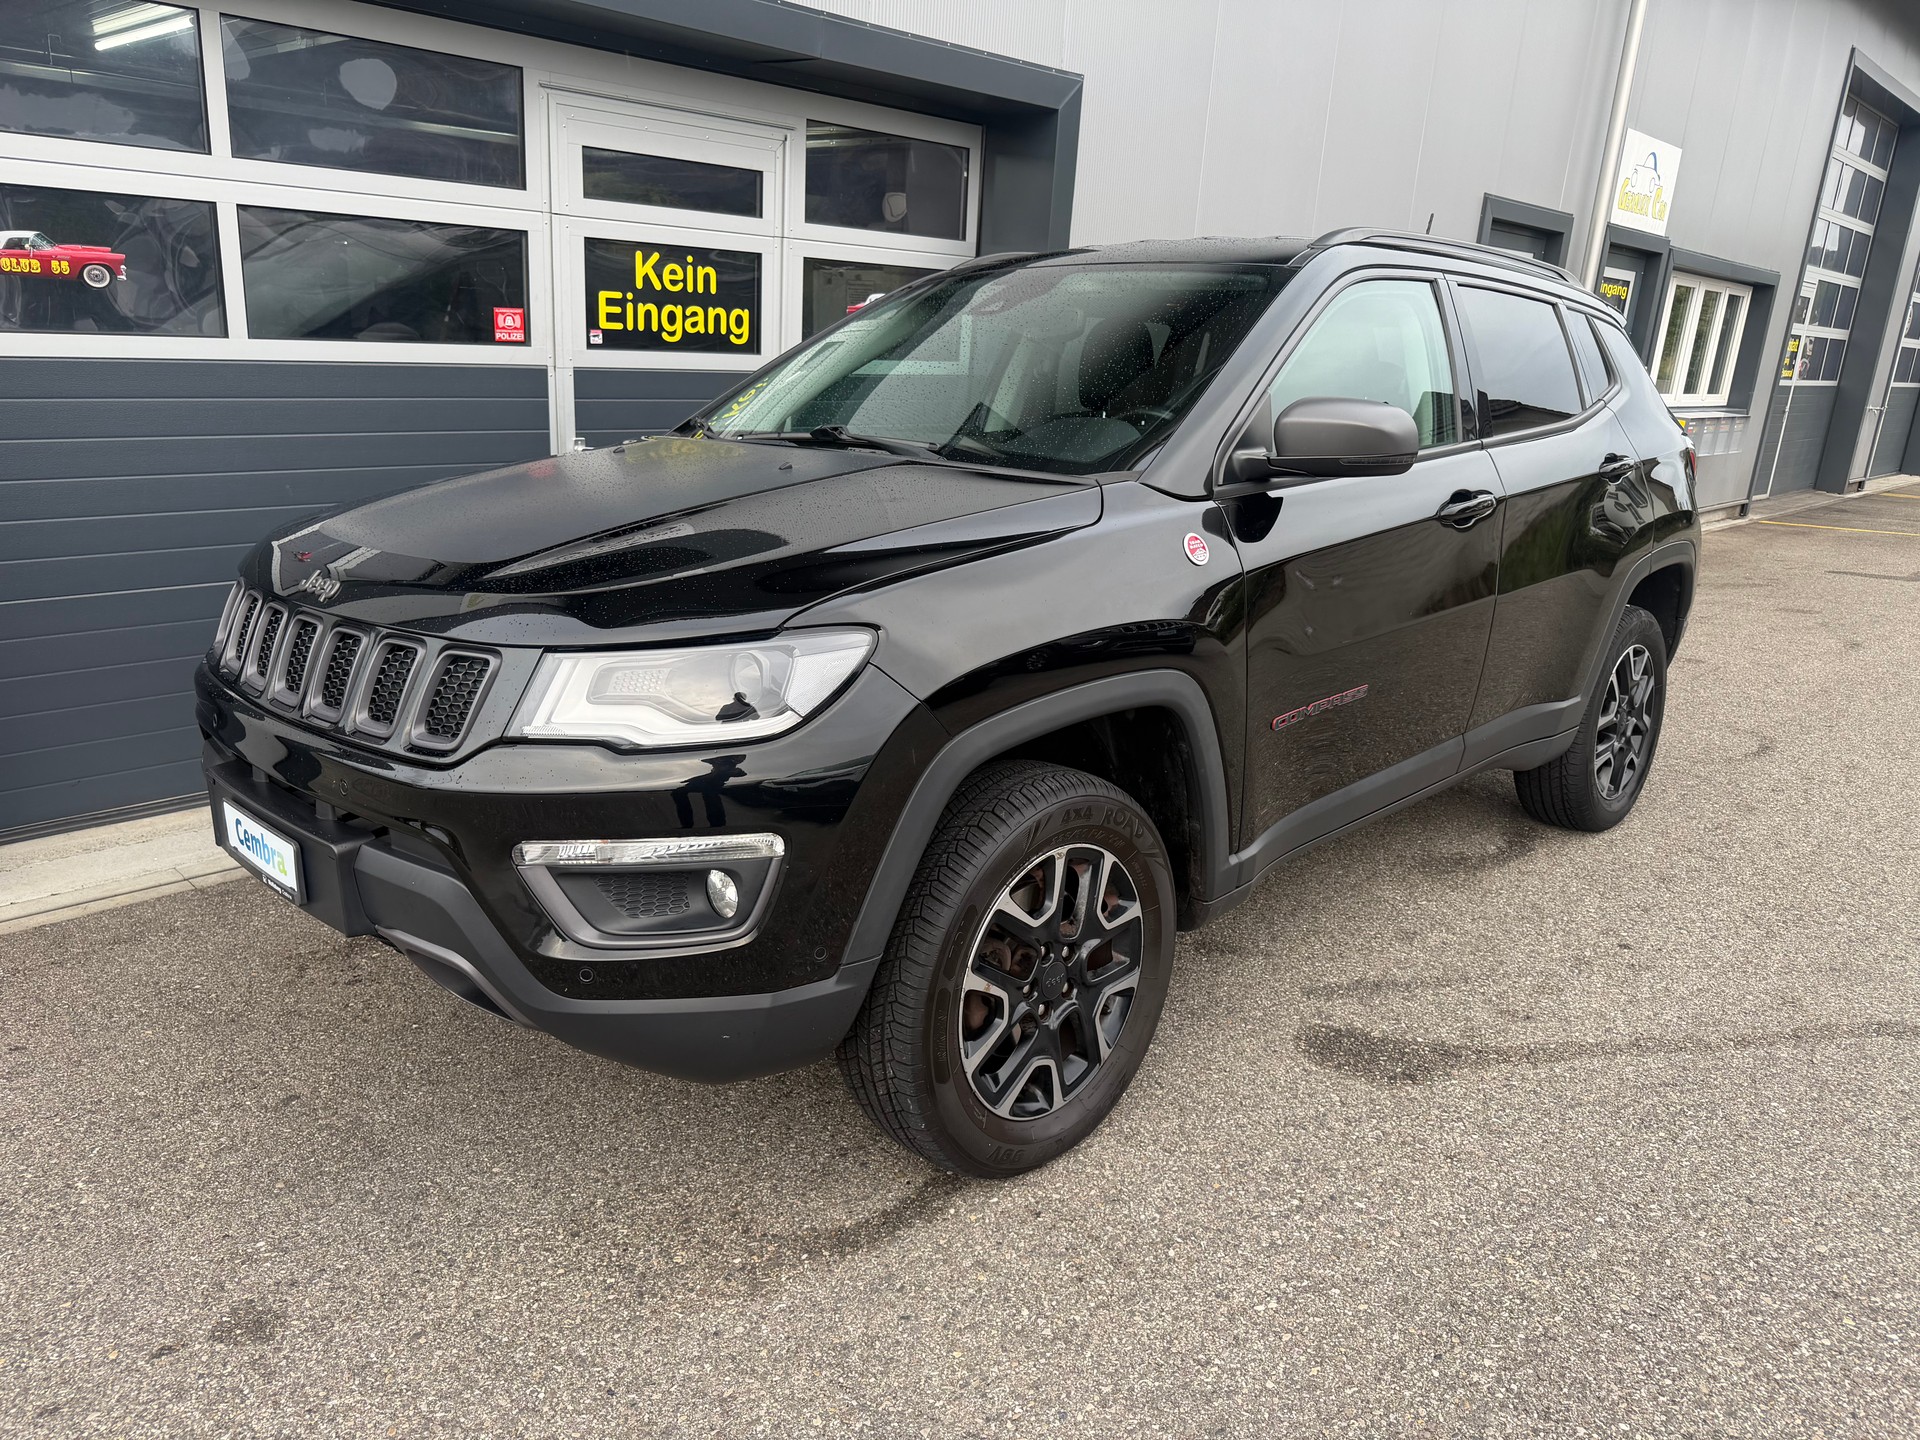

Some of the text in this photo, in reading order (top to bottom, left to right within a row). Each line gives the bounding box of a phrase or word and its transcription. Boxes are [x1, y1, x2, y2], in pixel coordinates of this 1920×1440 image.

[0, 257, 70, 275] CLUB 55
[635, 250, 717, 295] Kein
[1599, 280, 1628, 300] ingang
[598, 290, 750, 345] Eingang
[495, 332, 525, 341] POLIZEI
[299, 570, 341, 602] Jeep
[1270, 684, 1369, 731] COMPASS
[1099, 805, 1144, 840] ROAD
[235, 817, 288, 876] Cembra
